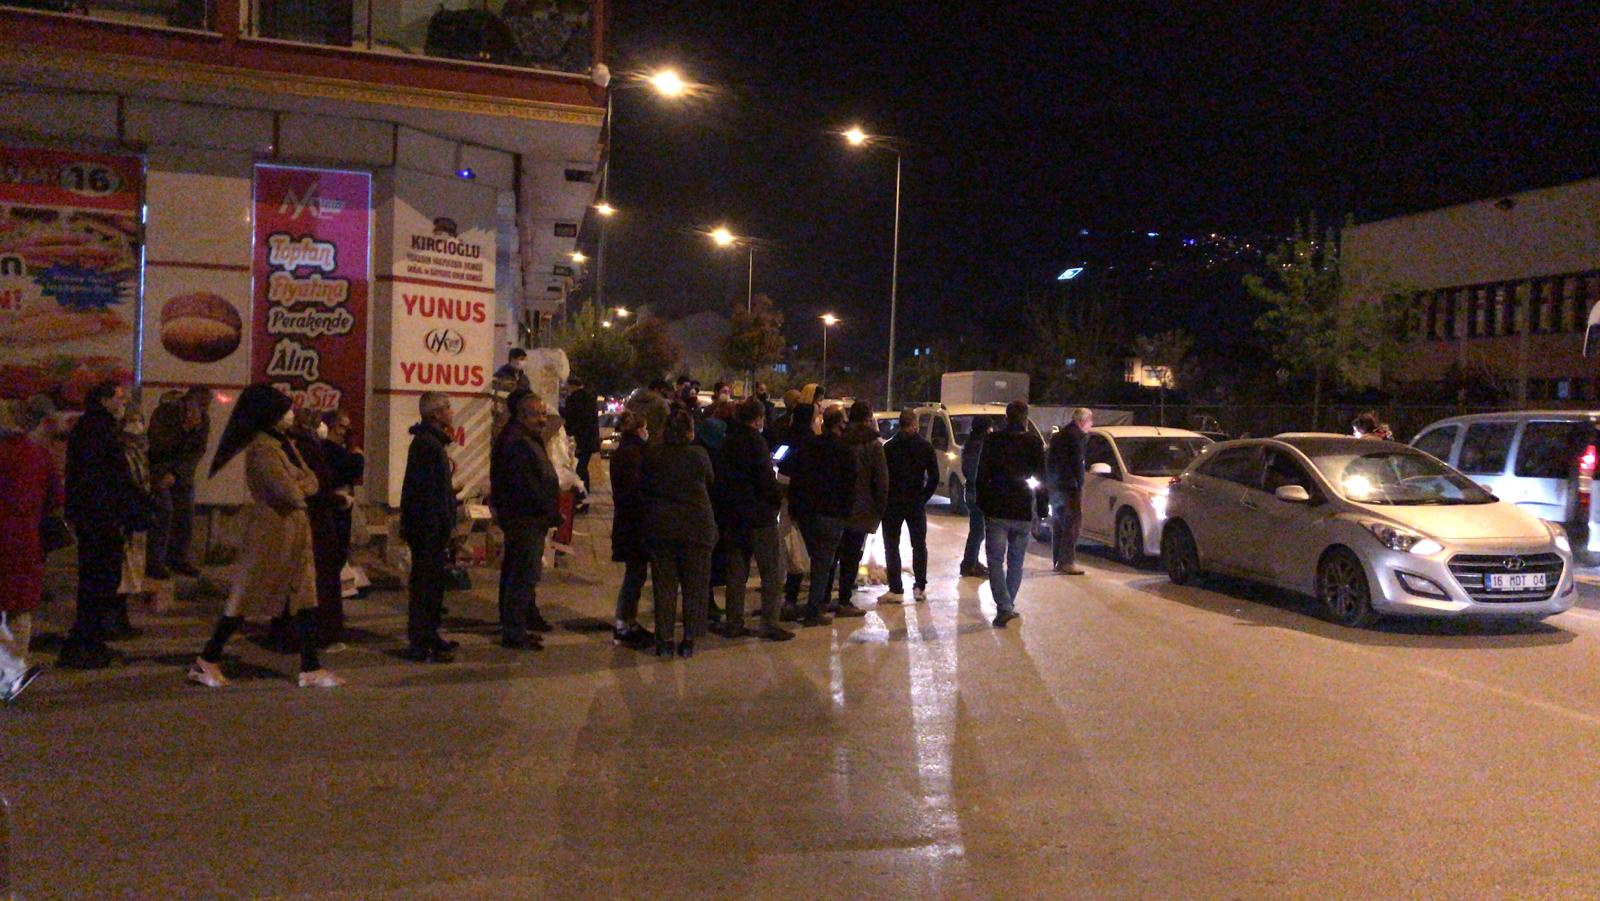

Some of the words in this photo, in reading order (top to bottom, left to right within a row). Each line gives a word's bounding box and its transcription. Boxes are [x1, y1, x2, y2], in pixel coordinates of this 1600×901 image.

[71, 166, 111, 192] 16
[271, 236, 333, 268] Toptan
[271, 309, 351, 332] Perakende
[402, 293, 486, 323] YUNUS
[400, 362, 484, 386] YUNUS
[1493, 575, 1503, 586] 16
[1509, 575, 1526, 586] MDT
[1533, 575, 1544, 586] 04
